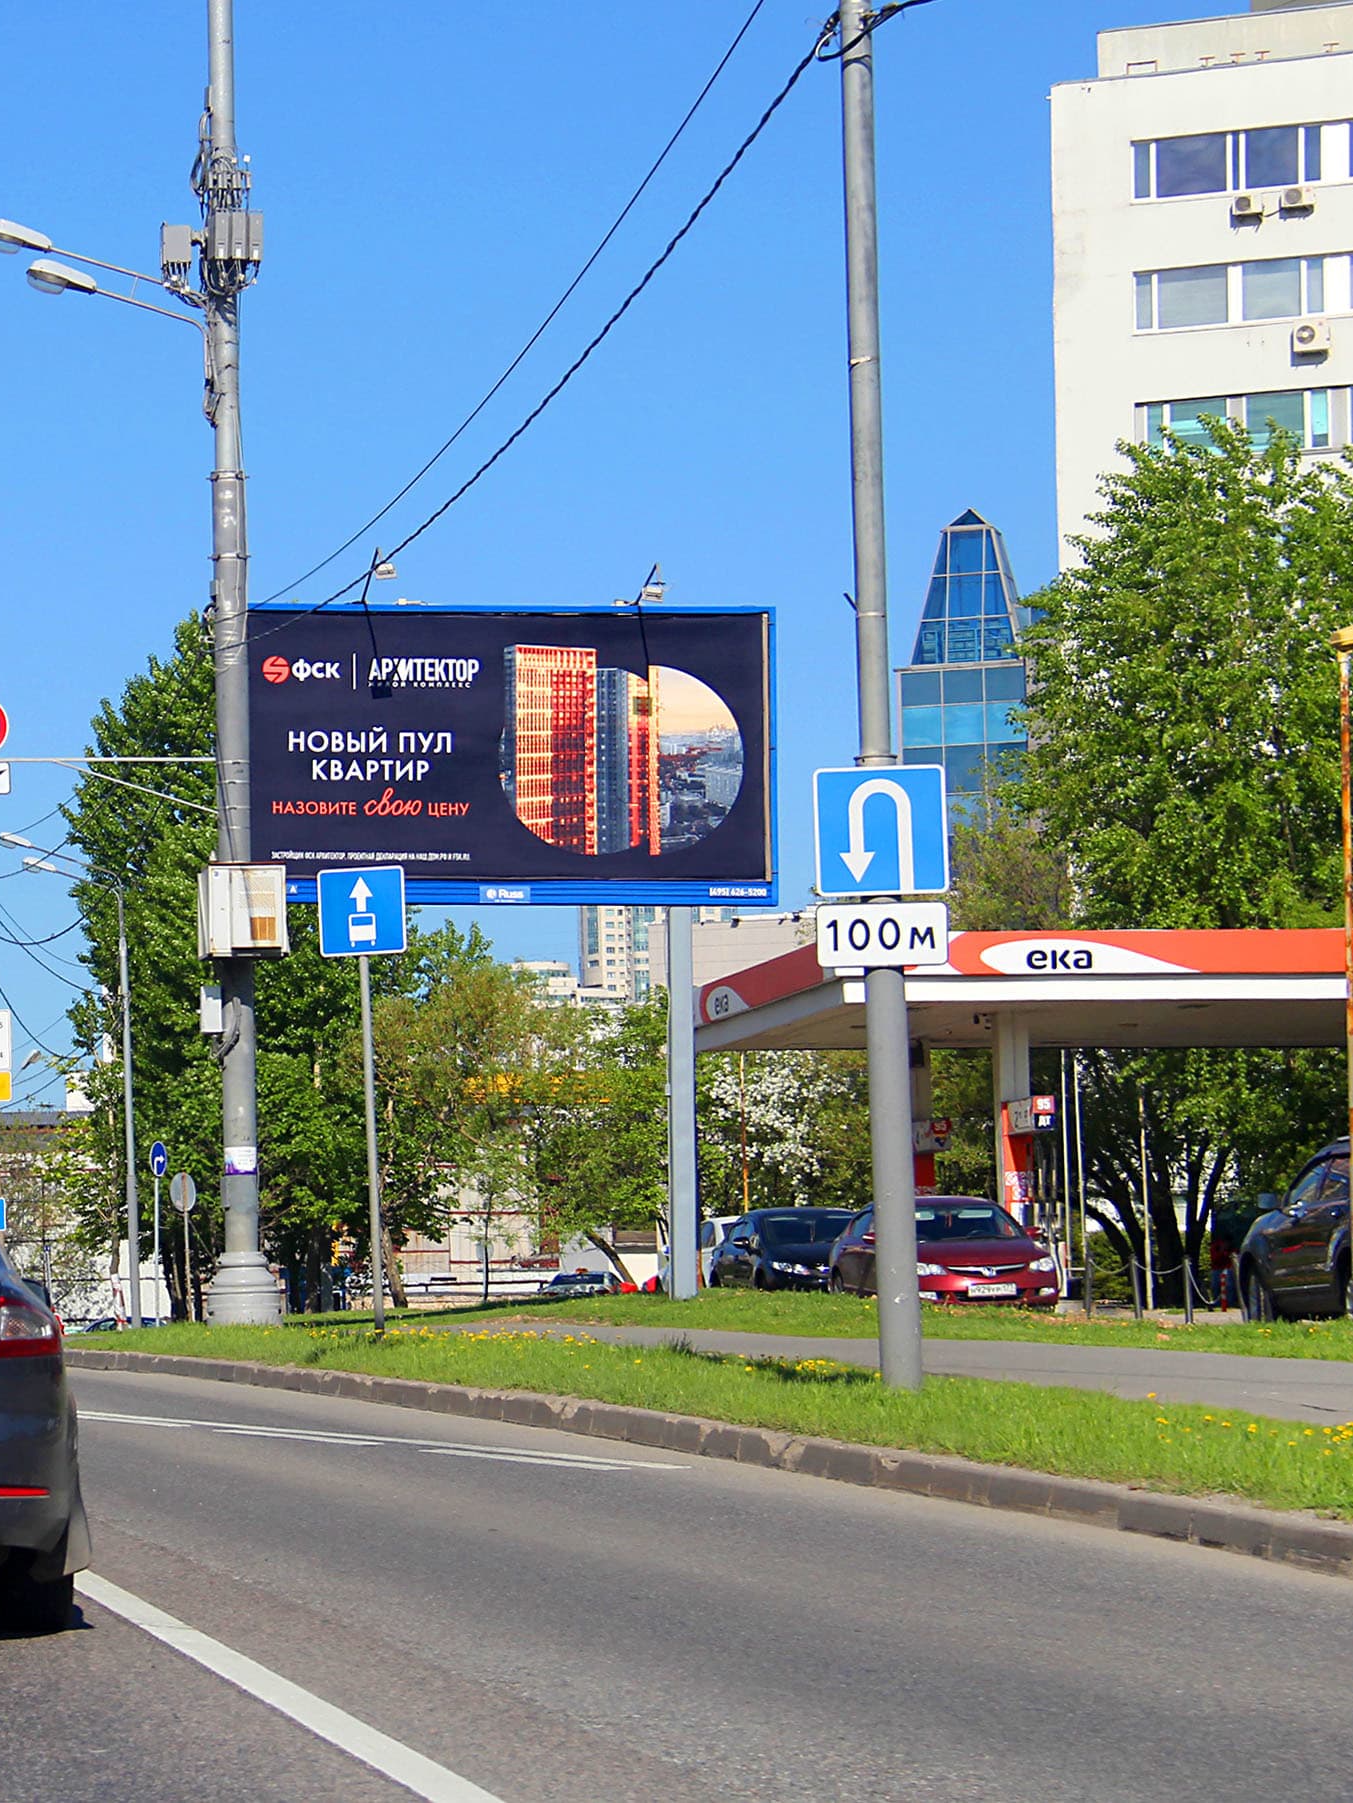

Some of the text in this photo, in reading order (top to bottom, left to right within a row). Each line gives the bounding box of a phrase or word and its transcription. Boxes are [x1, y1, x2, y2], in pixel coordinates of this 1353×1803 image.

[291, 657, 341, 682] ФСК
[367, 657, 480, 682] АРХИТЕКТОР
[287, 726, 453, 754] НОВЫЙ ПУЛ
[311, 759, 430, 782] КВАРТИР
[271, 787, 470, 818] НАЗОВИТЕ свою ЦЕНУ
[1026, 948, 1093, 970] ека
